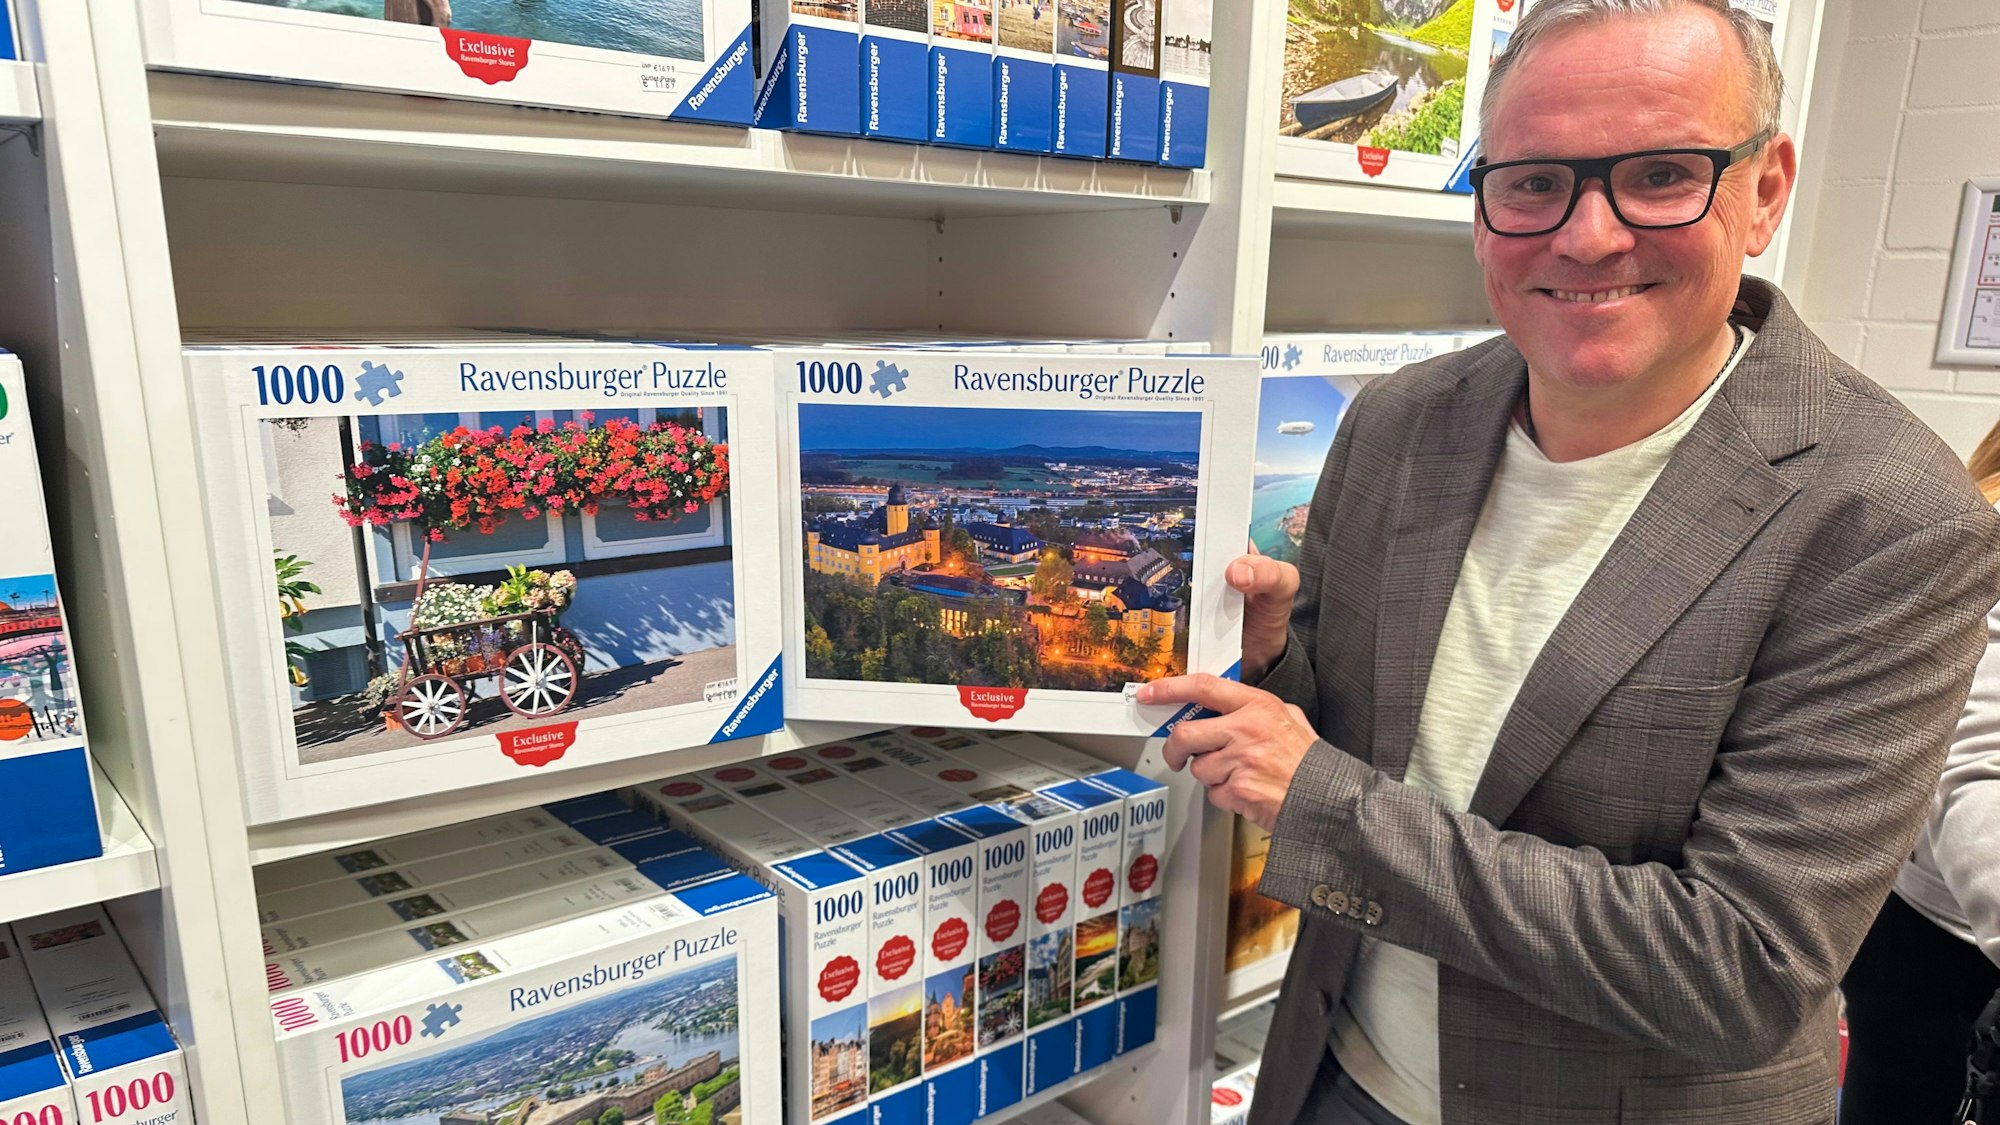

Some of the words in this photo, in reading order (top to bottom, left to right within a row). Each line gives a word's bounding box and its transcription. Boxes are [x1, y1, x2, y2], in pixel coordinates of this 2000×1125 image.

[459, 38, 514, 58] Exclusive
[688, 40, 749, 111] Ravensburger
[797, 32, 808, 122] Ravensburger
[869, 42, 880, 130] Ravensburger
[936, 52, 948, 138] Ravensburger
[999, 63, 1010, 145] Ravensburger
[1056, 70, 1068, 150] Ravensburger
[1113, 78, 1124, 155] Ravensburger
[1162, 87, 1174, 161] Ravensburger
[1401, 344, 1432, 360] Puzzle
[251, 364, 344, 405] 1000
[653, 361, 727, 389] Puzzle
[796, 361, 862, 394] 1000
[1128, 367, 1204, 394] Puzzle
[722, 668, 778, 737] Ravensburger
[971, 691, 1014, 702] Exclusive
[513, 731, 564, 747] Exclusive
[1082, 812, 1119, 840] 1000
[1129, 799, 1164, 826] 1000
[984, 839, 1024, 871] 1000
[1035, 825, 1073, 855] 1000
[874, 871, 919, 905] 1000
[930, 856, 973, 888] 1000
[814, 890, 863, 924] 1000
[872, 917, 894, 930] Puzzle
[674, 926, 738, 961] Puzzle
[814, 938, 837, 950] Puzzle
[823, 965, 855, 980] Exclusive
[271, 998, 318, 1031] 1000
[334, 1015, 412, 1063] 1000
[85, 1072, 174, 1123] 1000
